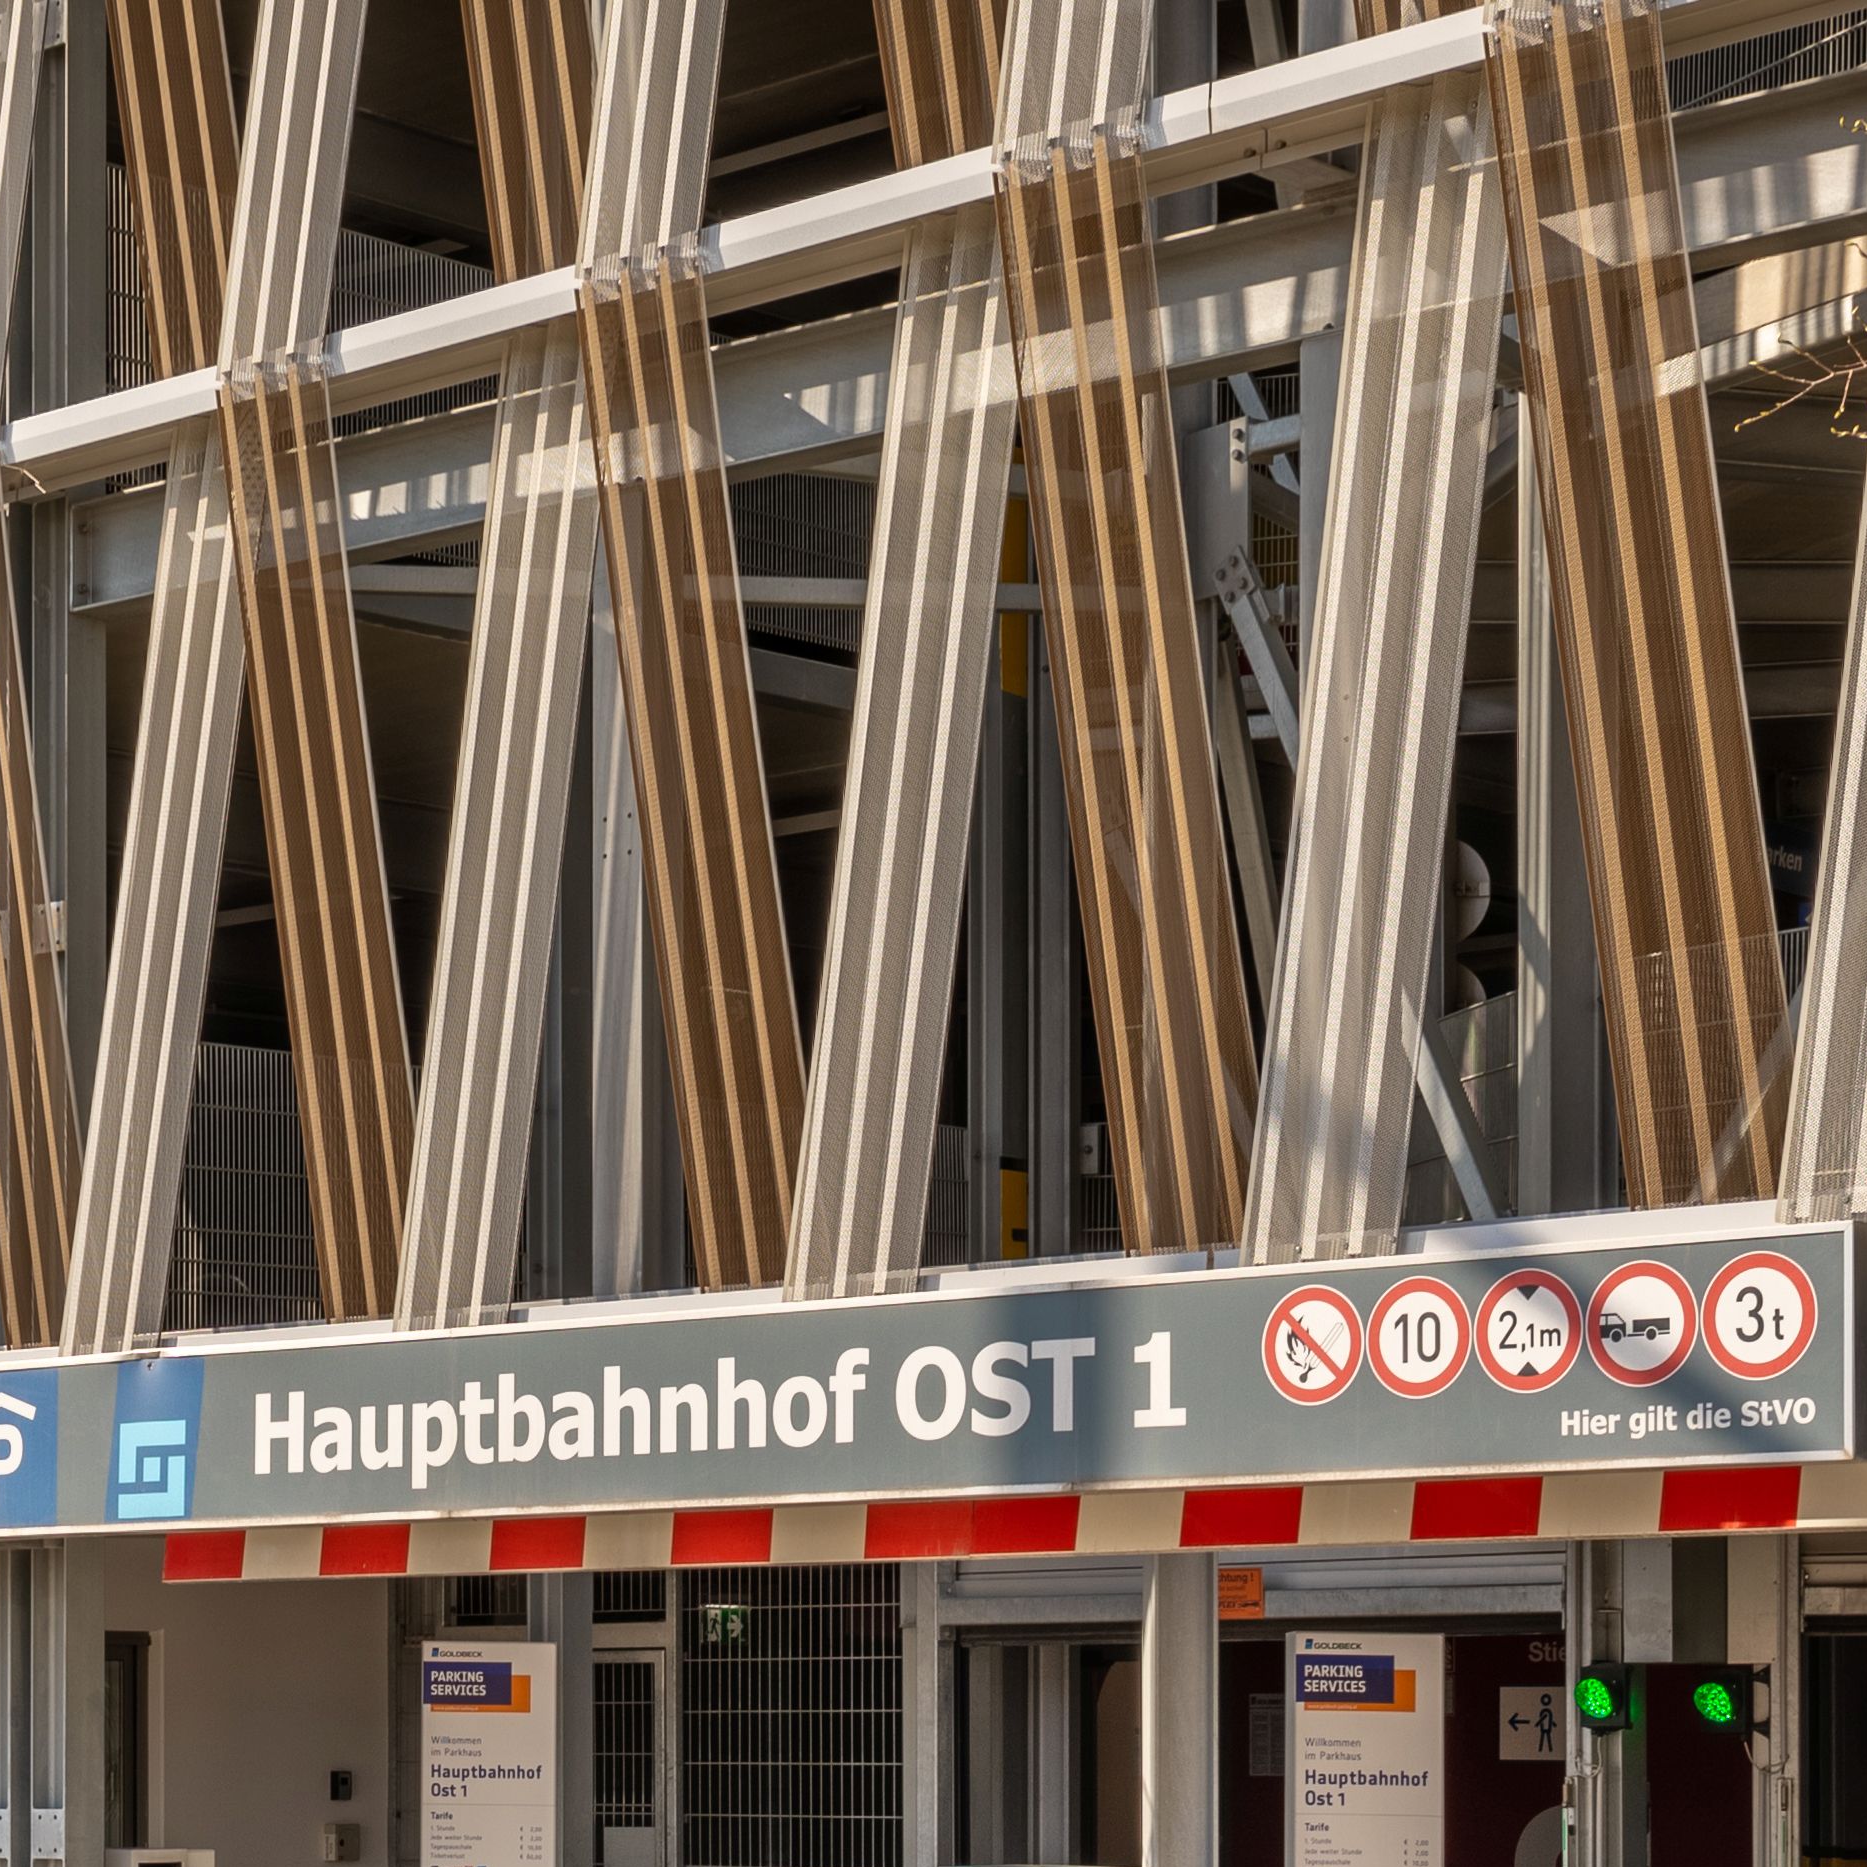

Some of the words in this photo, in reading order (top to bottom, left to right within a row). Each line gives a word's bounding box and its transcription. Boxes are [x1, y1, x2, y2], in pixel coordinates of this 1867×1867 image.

[1392, 1310, 1442, 1365] 10
[253, 1345, 871, 1490] Hauptbahnhof
[894, 1334, 1096, 1443] OST
[1131, 1329, 1188, 1429] 1
[1560, 1405, 1620, 1437] Hier
[1628, 1401, 1679, 1440] gilt
[1686, 1400, 1732, 1432] die
[1741, 1397, 1816, 1430] StVO
[1314, 1642, 1362, 1650] GOLDBECK
[439, 1650, 483, 1658] GOLDBECK
[431, 1670, 484, 1683] PARKING
[1304, 1664, 1363, 1678] PARKING
[431, 1684, 487, 1697] SERVICES
[1304, 1680, 1366, 1693] SERVICES
[431, 1736, 482, 1745] Willkommen
[1305, 1737, 1361, 1748] Willkommen
[431, 1748, 441, 1757] im
[444, 1748, 482, 1757] Parkhaus
[1305, 1752, 1316, 1760] im
[1319, 1751, 1361, 1761] Parkhaus
[431, 1765, 542, 1781] Hauptbahnhof
[1305, 1769, 1429, 1788] Hauptbahnhof
[431, 1784, 456, 1797] Ost
[461, 1784, 468, 1797] 1
[1305, 1791, 1333, 1806] Ost
[1337, 1792, 1346, 1806] 1
[431, 1812, 453, 1821] Tarife
[1305, 1822, 1329, 1832] Tarife
